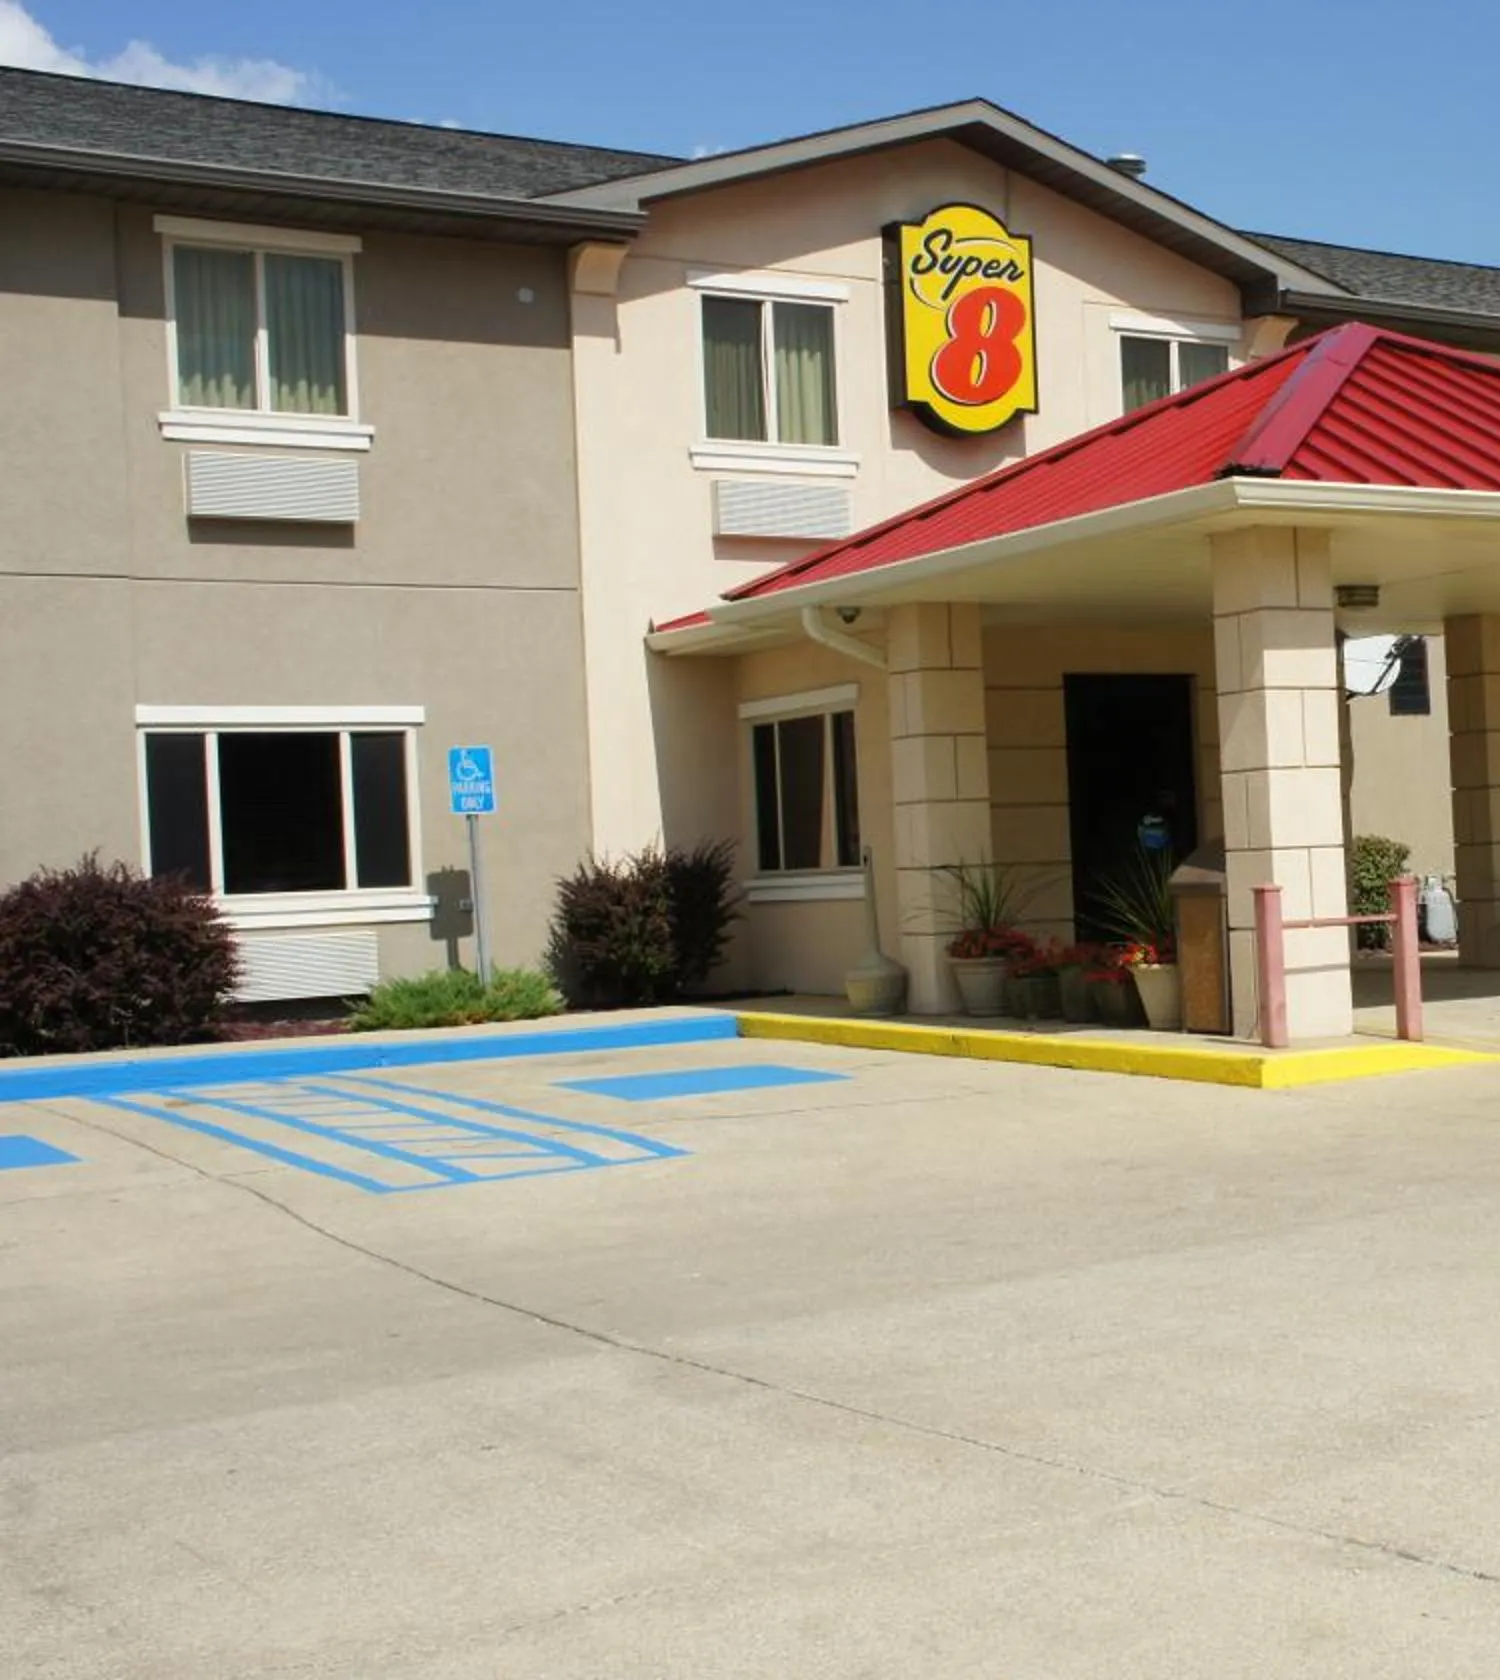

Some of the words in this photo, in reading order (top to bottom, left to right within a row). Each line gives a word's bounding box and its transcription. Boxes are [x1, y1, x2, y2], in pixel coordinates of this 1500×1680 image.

[911, 228, 1025, 301] Super
[930, 286, 1026, 406] 8
[451, 780, 491, 795] PARKING
[461, 795, 484, 809] ONLY
